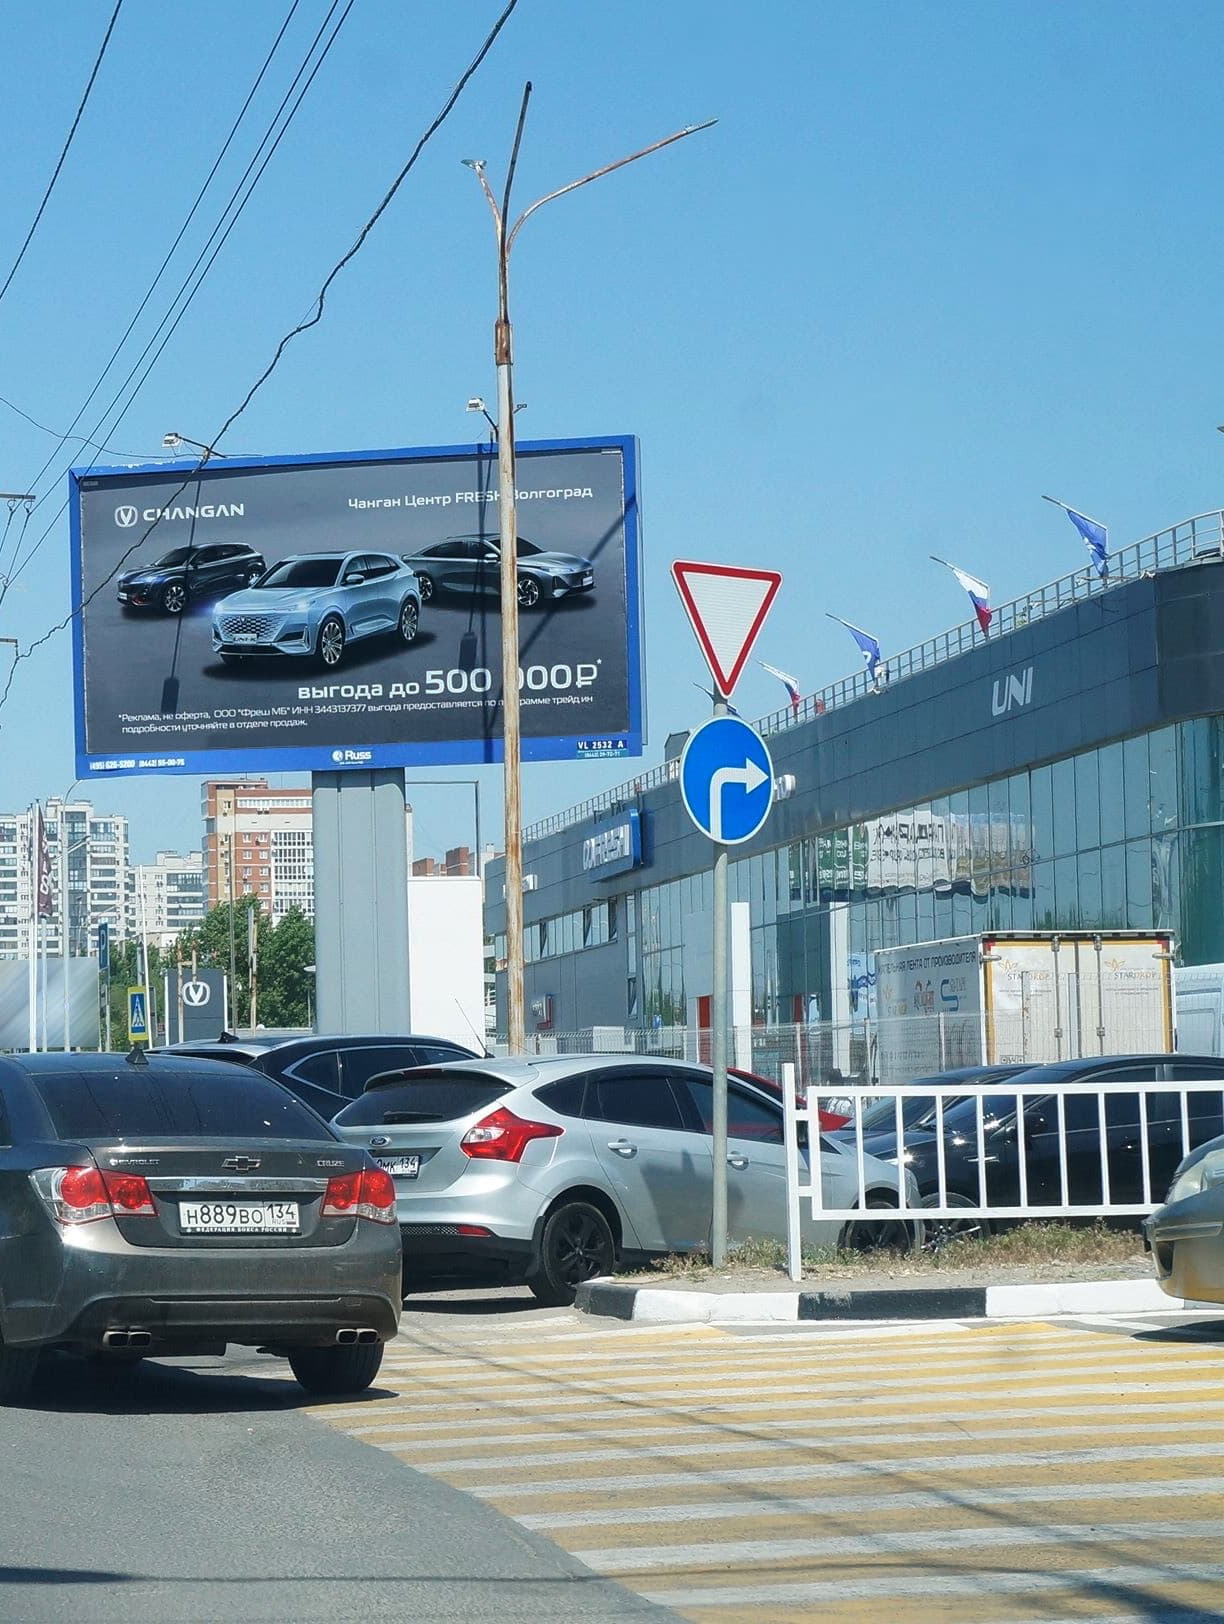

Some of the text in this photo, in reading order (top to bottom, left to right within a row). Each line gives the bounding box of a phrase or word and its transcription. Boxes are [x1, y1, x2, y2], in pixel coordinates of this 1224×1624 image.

[348, 498, 401, 509] Чанган
[404, 494, 452, 507] Центр
[142, 503, 245, 522] CHANGAN
[298, 683, 383, 700] выгода
[389, 681, 420, 699] до
[425, 668, 492, 695] 500
[992, 666, 1034, 717] UNI
[291, 705, 313, 715] ИНН
[367, 703, 402, 712] выгода
[402, 700, 483, 711] предоставляется
[121, 723, 181, 734] подробности
[236, 720, 268, 729] отделе
[578, 741, 589, 749] VL
[345, 750, 372, 760] Russ
[109, 1158, 160, 1166] EVROLET
[399, 1156, 416, 1169] 134
[267, 1203, 296, 1219] 134
